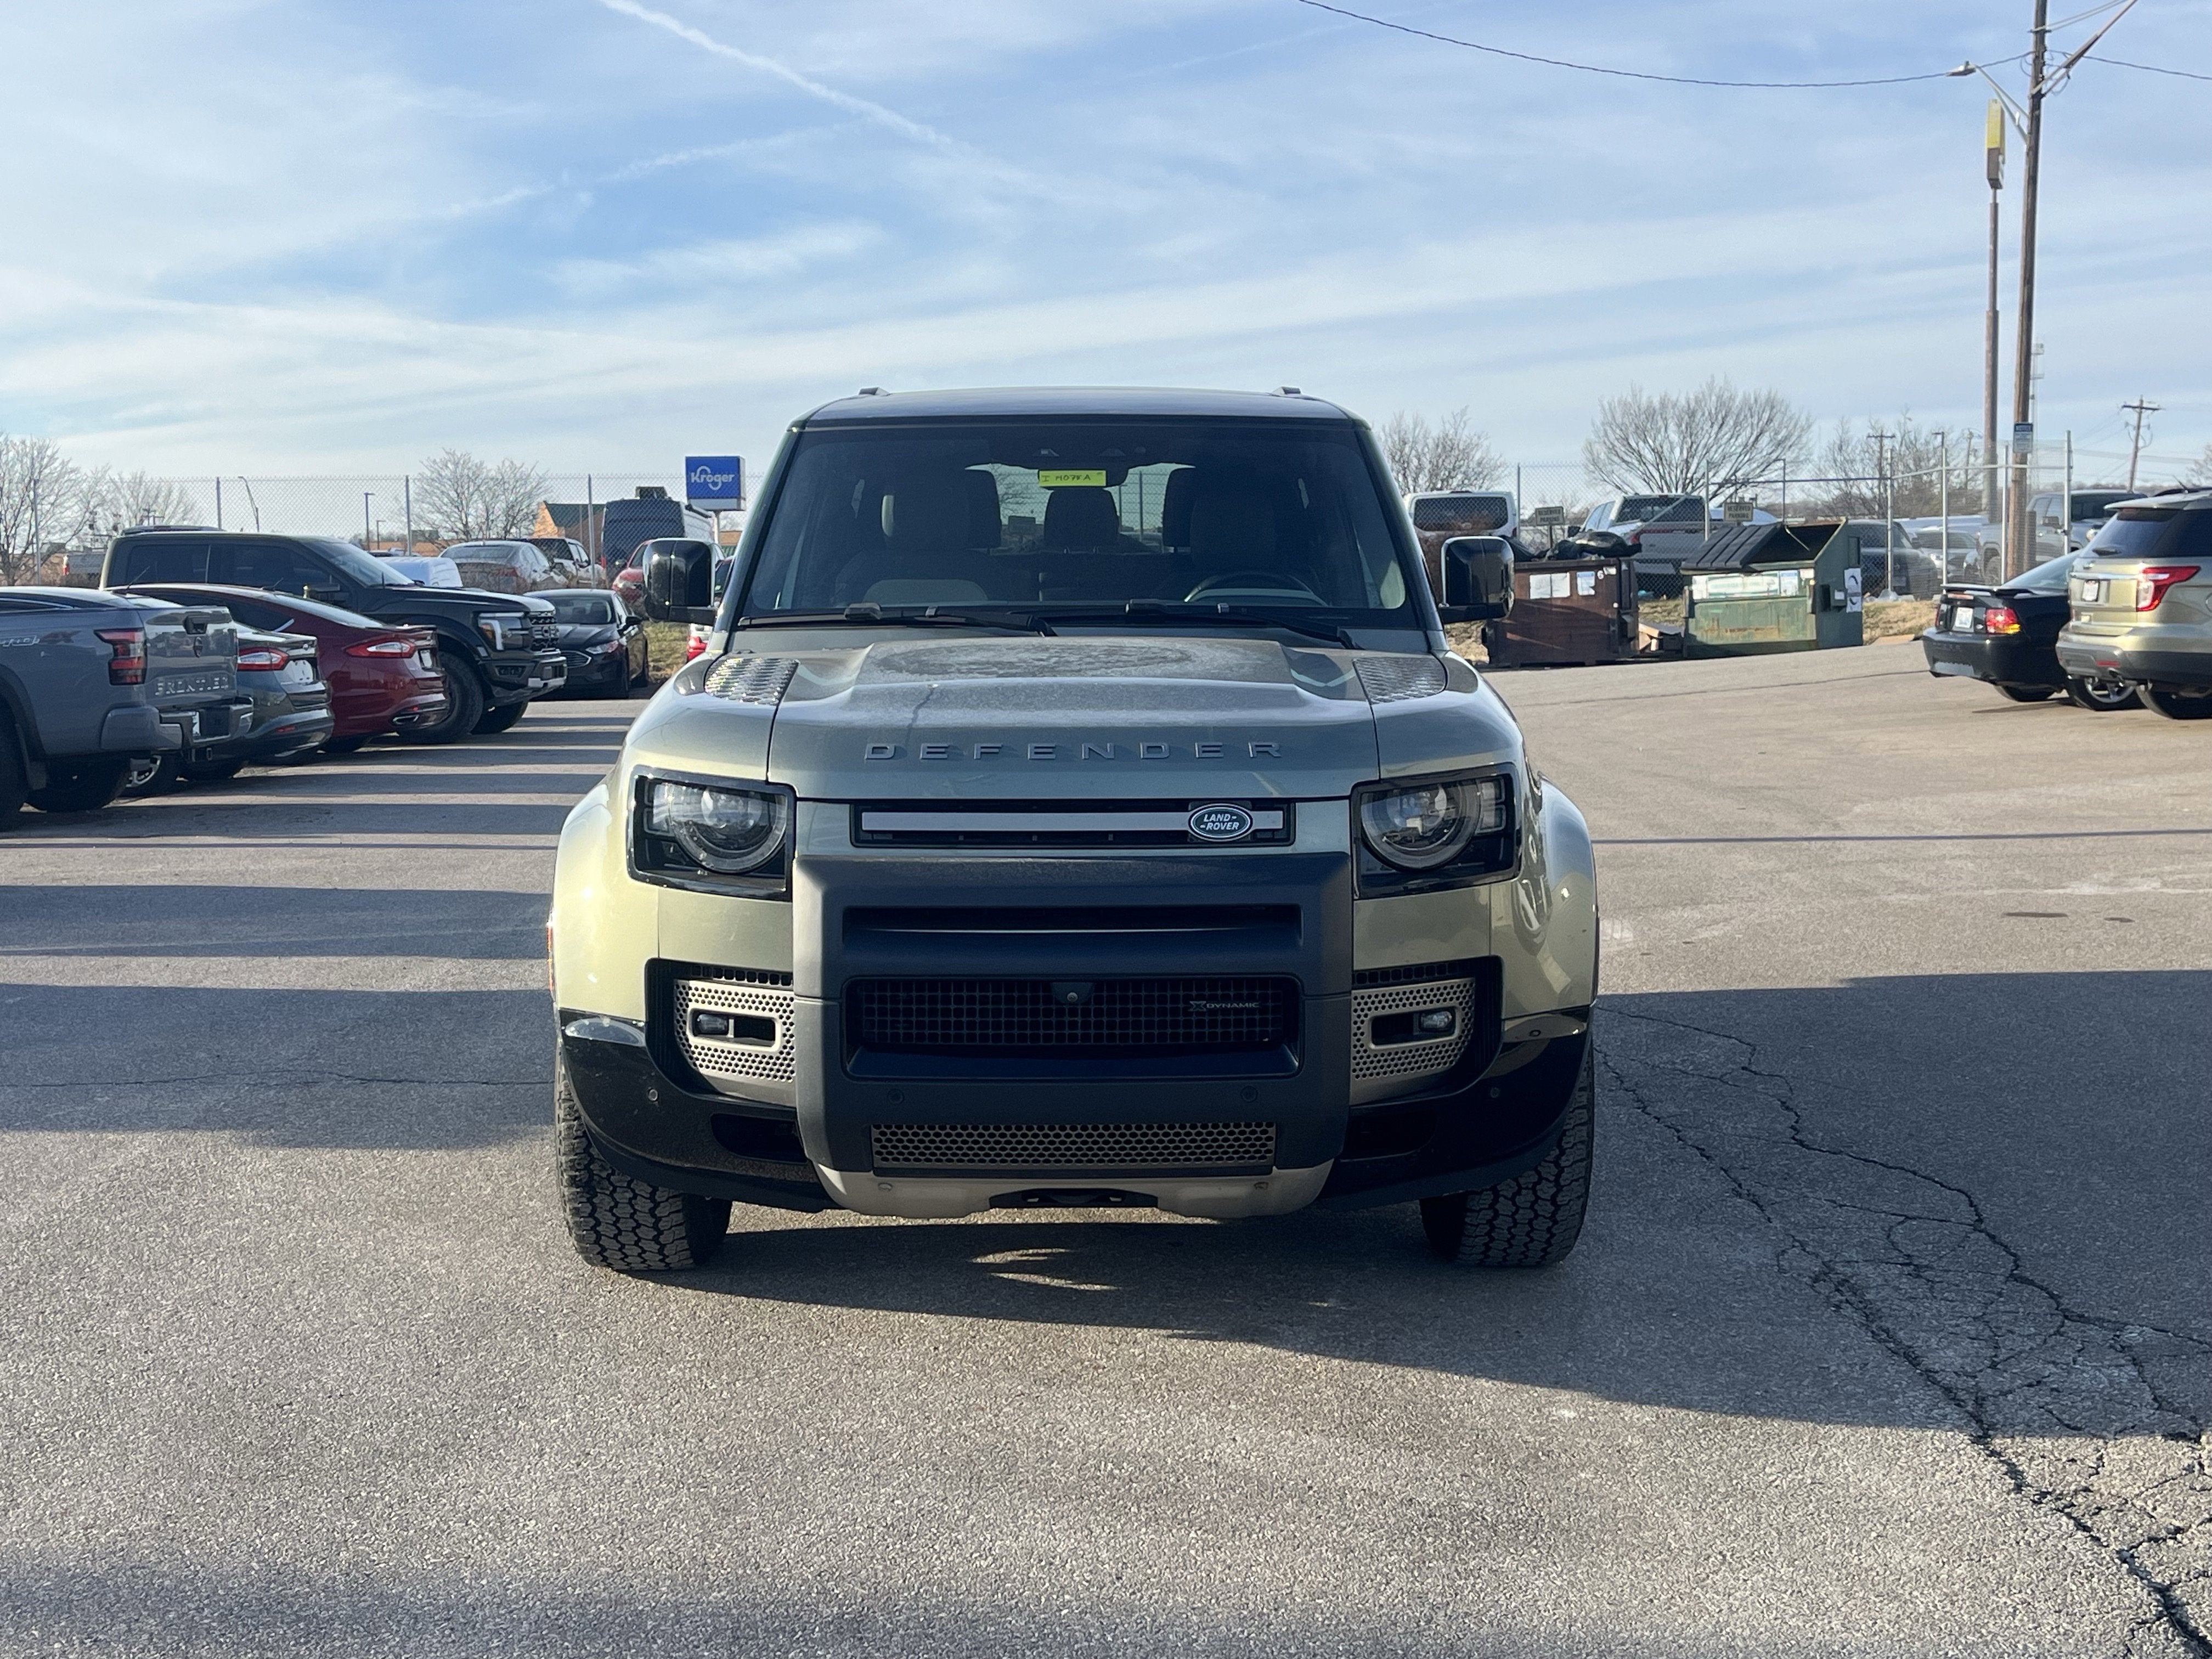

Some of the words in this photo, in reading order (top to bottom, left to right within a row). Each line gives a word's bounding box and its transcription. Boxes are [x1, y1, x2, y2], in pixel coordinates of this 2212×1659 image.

[691, 466, 735, 490] Kroger
[155, 676, 229, 695] FRONTIER
[865, 742, 1282, 760] DEFENDER
